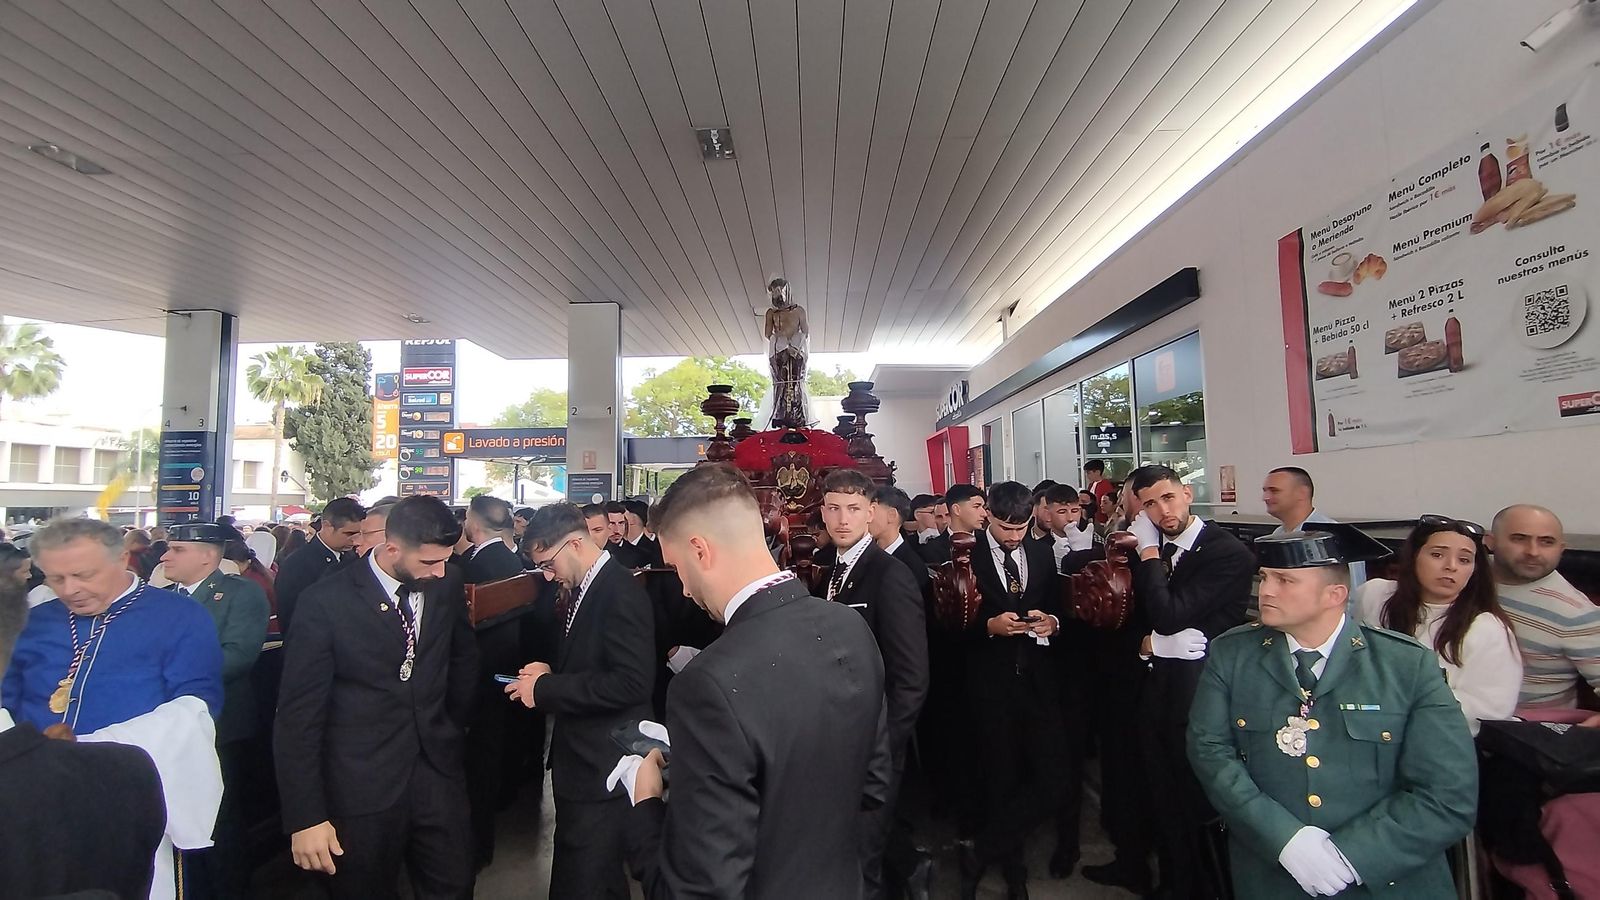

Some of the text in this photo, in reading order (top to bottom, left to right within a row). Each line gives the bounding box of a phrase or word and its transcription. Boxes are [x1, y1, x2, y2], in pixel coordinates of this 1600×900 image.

[1418, 155, 1471, 186] Completo
[1332, 203, 1372, 229] Desayuno
[1423, 213, 1473, 240] Premium
[1318, 224, 1354, 248] Merienda
[1497, 249, 1589, 284] nuestros menús
[1515, 245, 1565, 267] Consulta
[1418, 290, 1425, 299] 2
[1428, 278, 1464, 296] Pizzas
[1401, 299, 1444, 318] Refresco
[1447, 293, 1454, 303] 2
[1458, 290, 1465, 300] L
[1322, 329, 1348, 343] Bebida
[1350, 324, 1360, 334] 50
[1363, 320, 1370, 330] cl
[1335, 316, 1355, 328] Pizza
[572, 407, 577, 416] 2
[606, 406, 612, 415] 1
[198, 419, 204, 427] 3
[376, 414, 387, 430] 5
[376, 434, 397, 449] 20
[469, 434, 565, 449] Lavado a presión
[188, 492, 199, 501] 10
